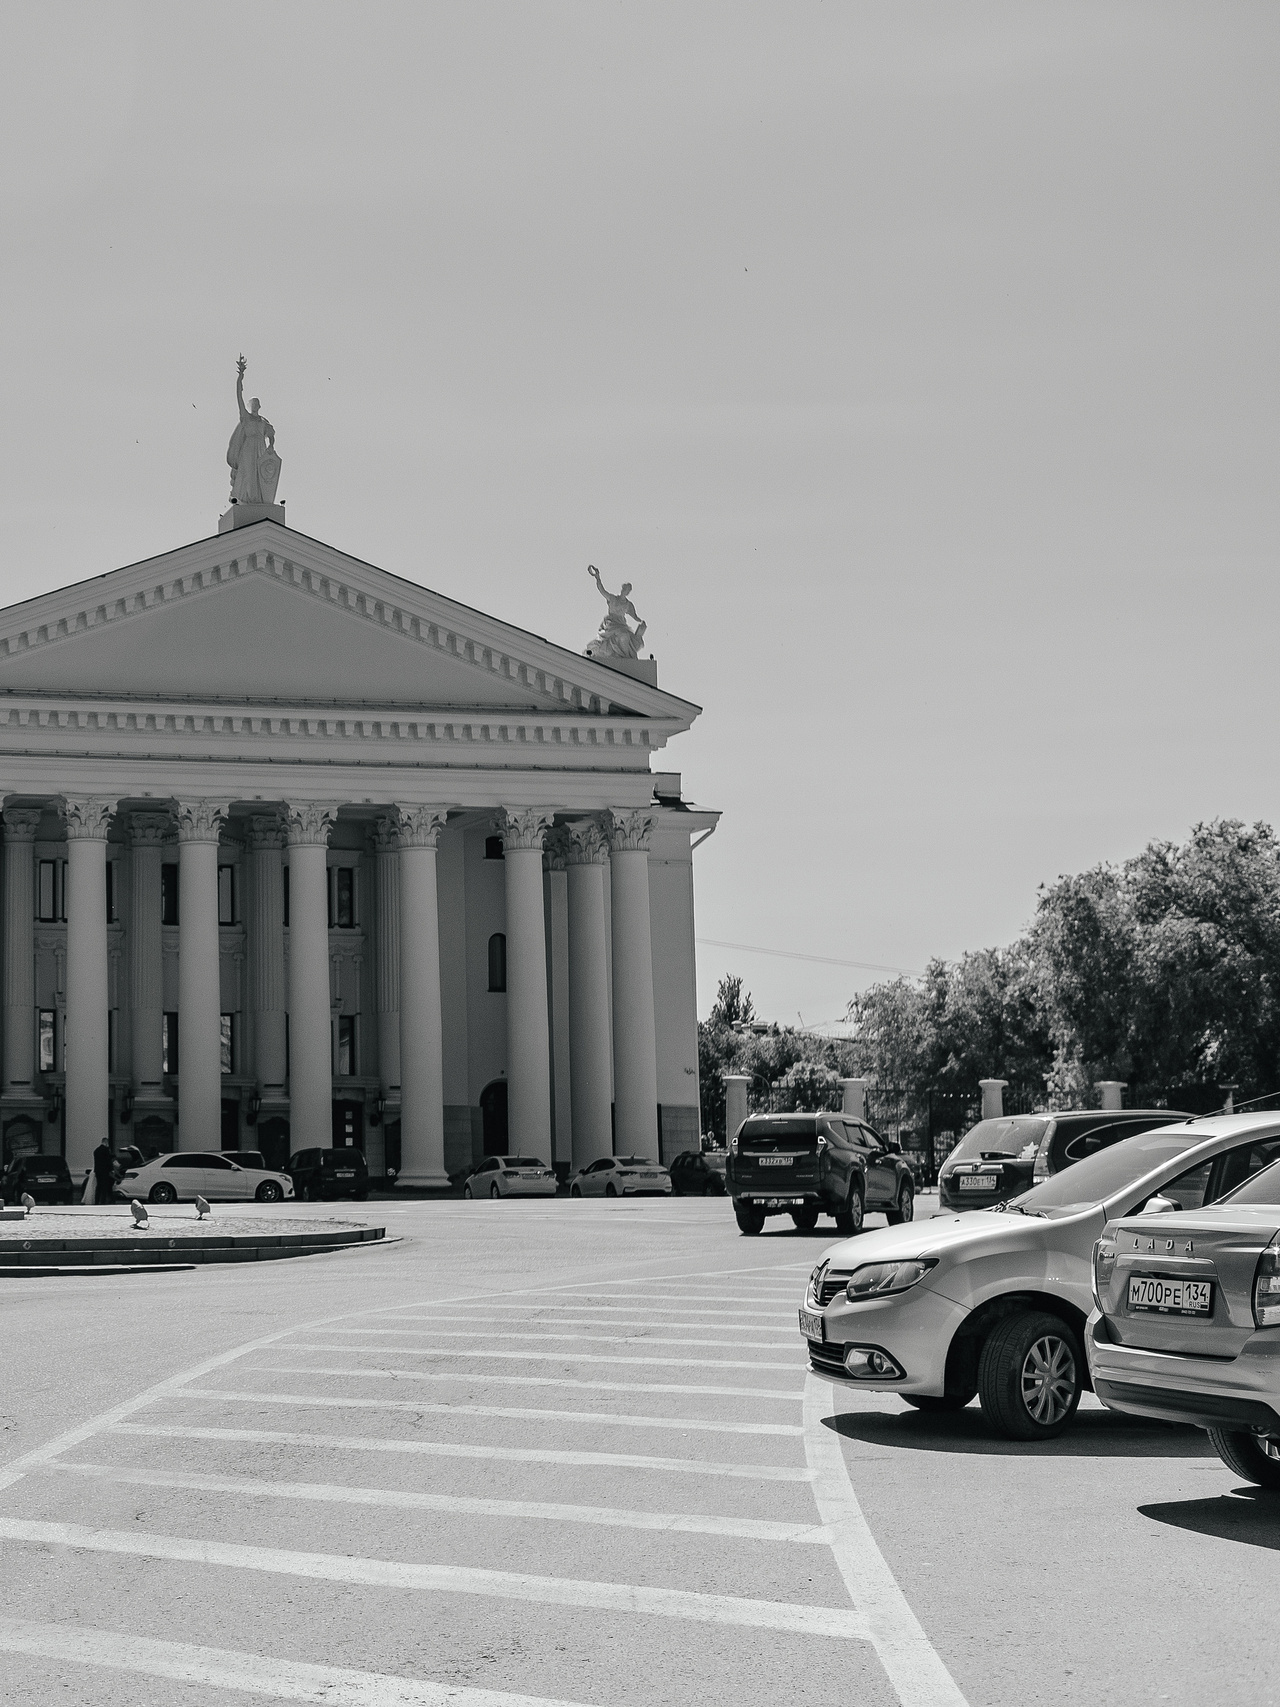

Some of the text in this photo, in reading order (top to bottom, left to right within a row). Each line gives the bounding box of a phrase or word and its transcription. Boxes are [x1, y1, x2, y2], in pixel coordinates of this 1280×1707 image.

[1133, 1238, 1194, 1252] LADA
[1131, 1281, 1207, 1305] М700РЕ 134
